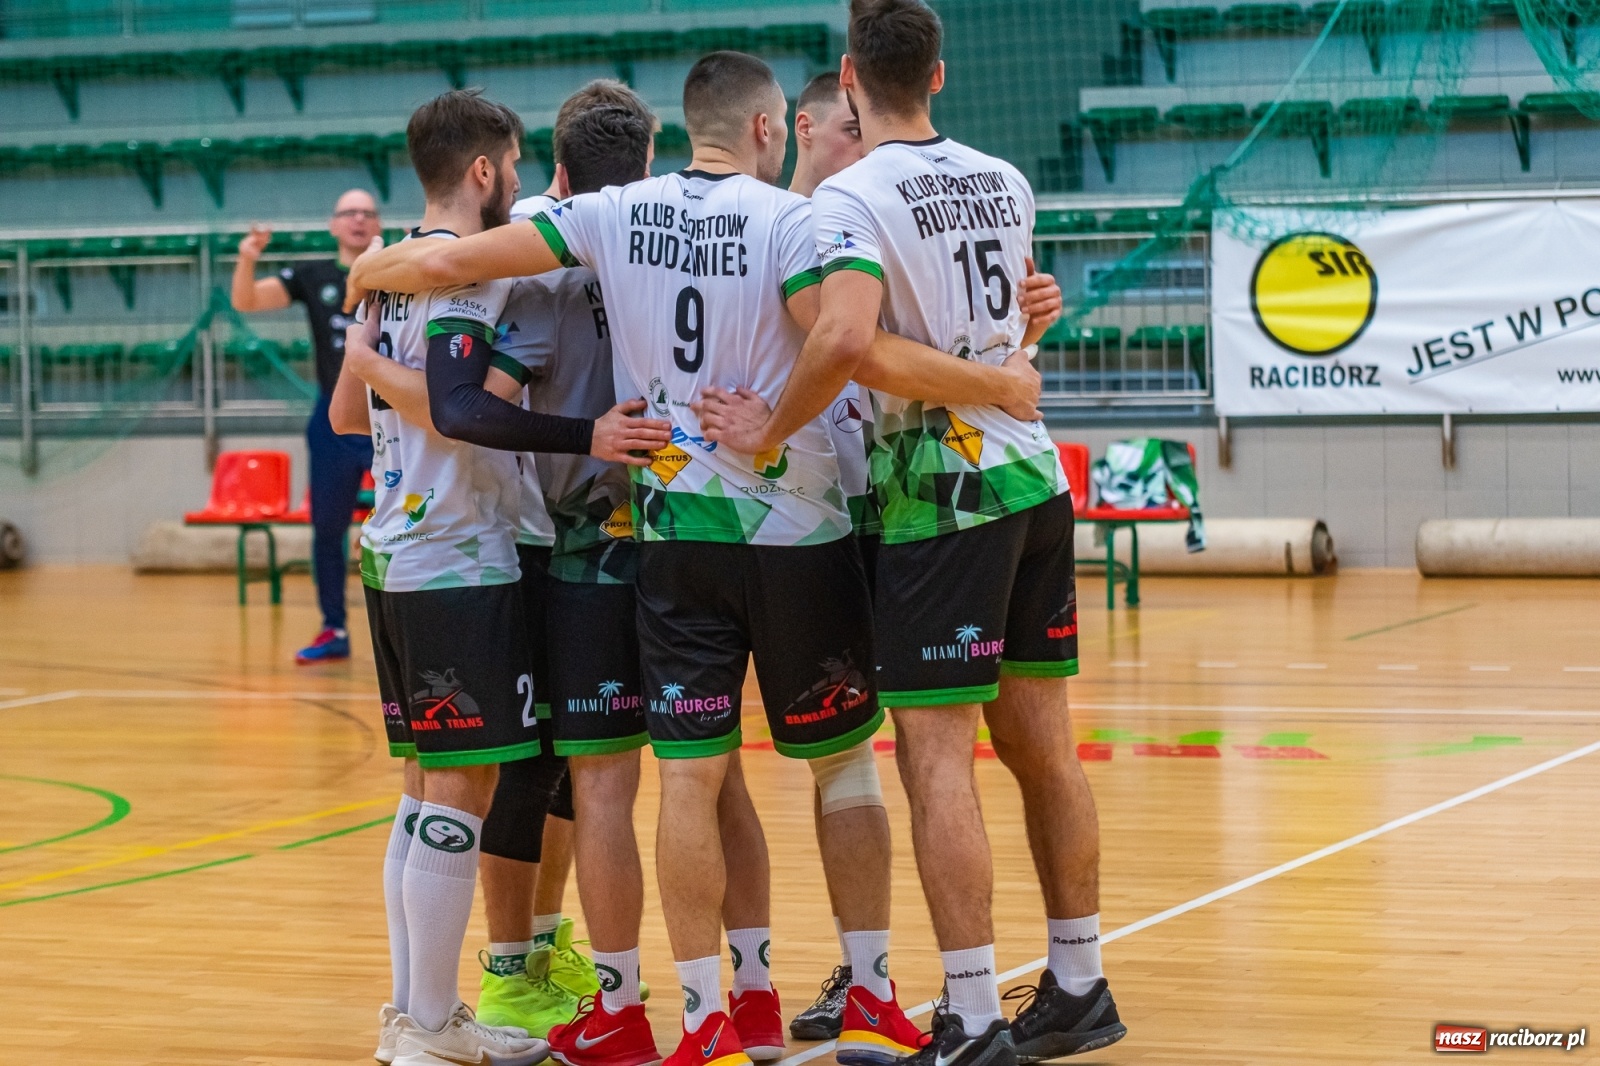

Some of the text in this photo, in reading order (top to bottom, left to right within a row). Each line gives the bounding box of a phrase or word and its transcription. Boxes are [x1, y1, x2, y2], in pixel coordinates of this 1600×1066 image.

[895, 172, 941, 205] KLUB
[630, 202, 749, 242] KLUB SORTOWY
[910, 195, 1021, 240] RUDZINIEC
[953, 239, 1011, 322] 15
[449, 296, 488, 317] ŚLĄSKA
[673, 285, 704, 374] 9
[1406, 320, 1496, 377] JEST
[1506, 306, 1544, 343] W
[1250, 361, 1382, 389] RACIBÓRZ
[921, 643, 963, 662] MIAMI
[516, 671, 538, 728] 2
[567, 698, 604, 713] MIAMI
[674, 694, 732, 715] BURGER
[445, 716, 485, 730] TRANS
[1052, 933, 1099, 946] Reebok
[945, 966, 992, 981] Reebok
